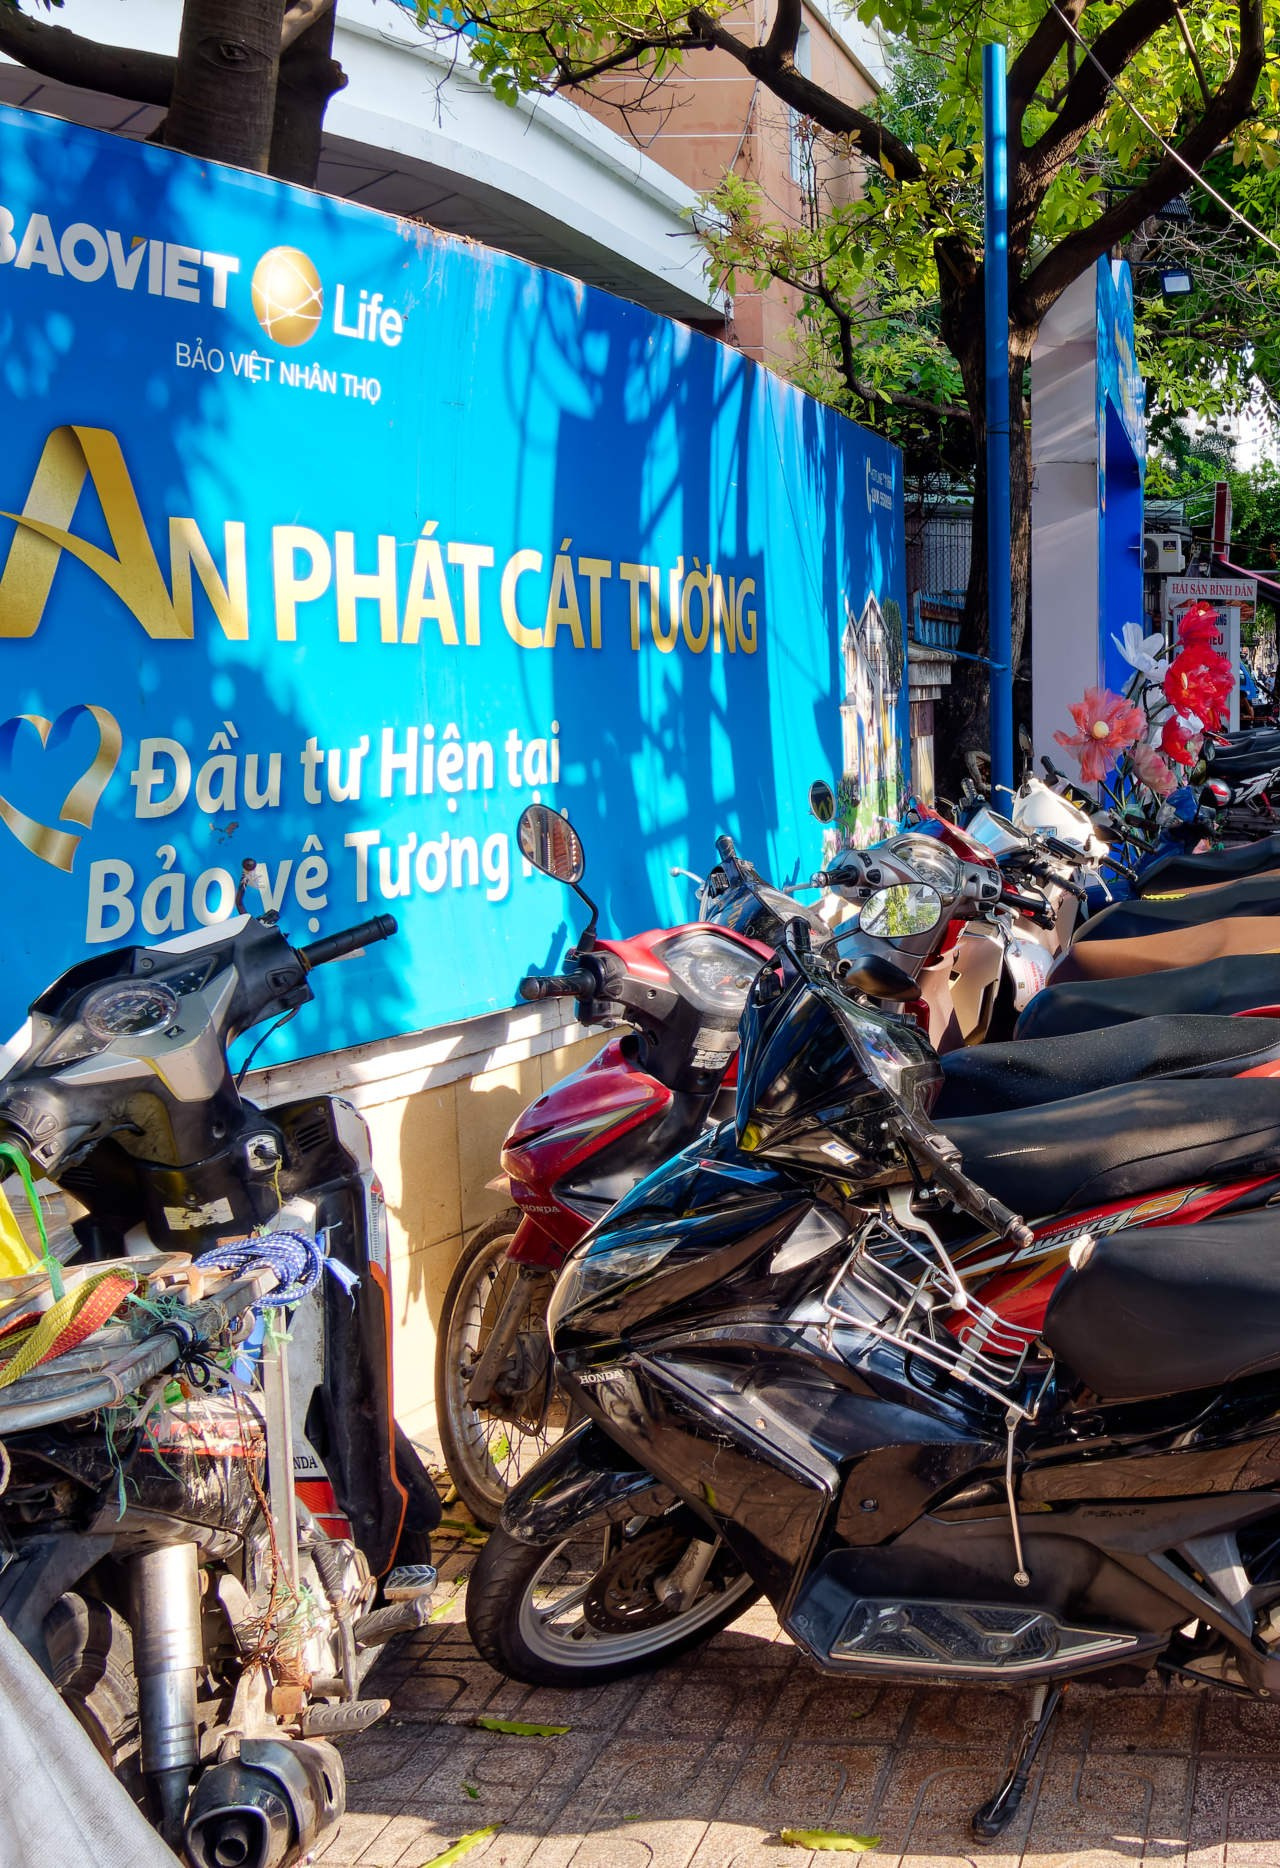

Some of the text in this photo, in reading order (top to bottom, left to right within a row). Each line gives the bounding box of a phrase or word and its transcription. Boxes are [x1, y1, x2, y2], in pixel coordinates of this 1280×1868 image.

[333, 283, 403, 347] Life
[175, 337, 381, 405] BẢO VIỆT NHÂN THỌ
[0, 425, 757, 655] AN PHÁT CÁT TƯỜNG
[130, 719, 561, 820] Đầu tư Hiện tại
[86, 843, 236, 944] Bảo
[258, 835, 329, 933] vệ
[344, 828, 511, 903] Tương
[520, 1203, 561, 1214] HONDA
[579, 1368, 625, 1385] HONDA
[292, 1456, 318, 1470] NDA
